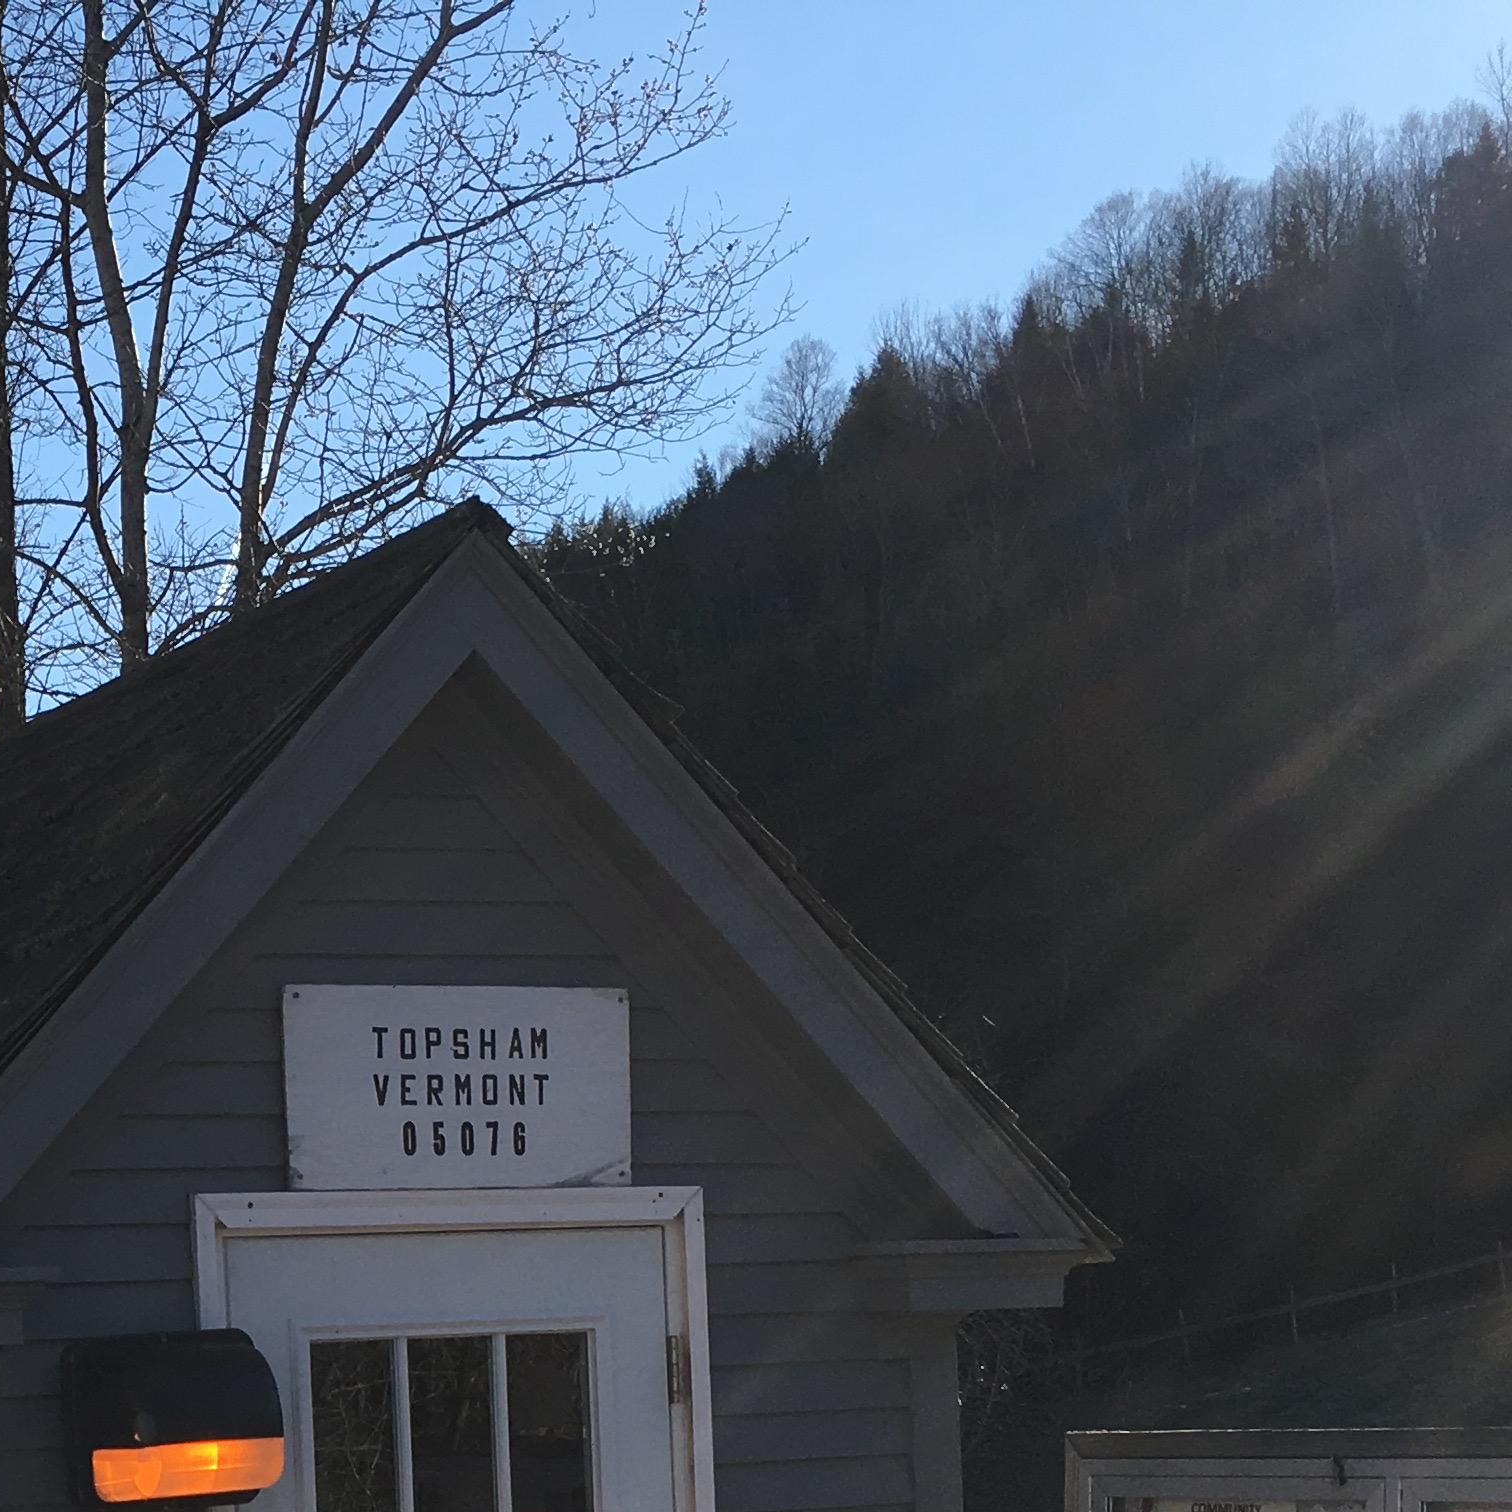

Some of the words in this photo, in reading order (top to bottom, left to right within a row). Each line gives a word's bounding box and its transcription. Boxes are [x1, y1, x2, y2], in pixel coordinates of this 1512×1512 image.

[372, 1026, 548, 1060] TOPSHAM
[373, 1073, 550, 1106] VERMONT
[402, 1120, 527, 1156] 05076
